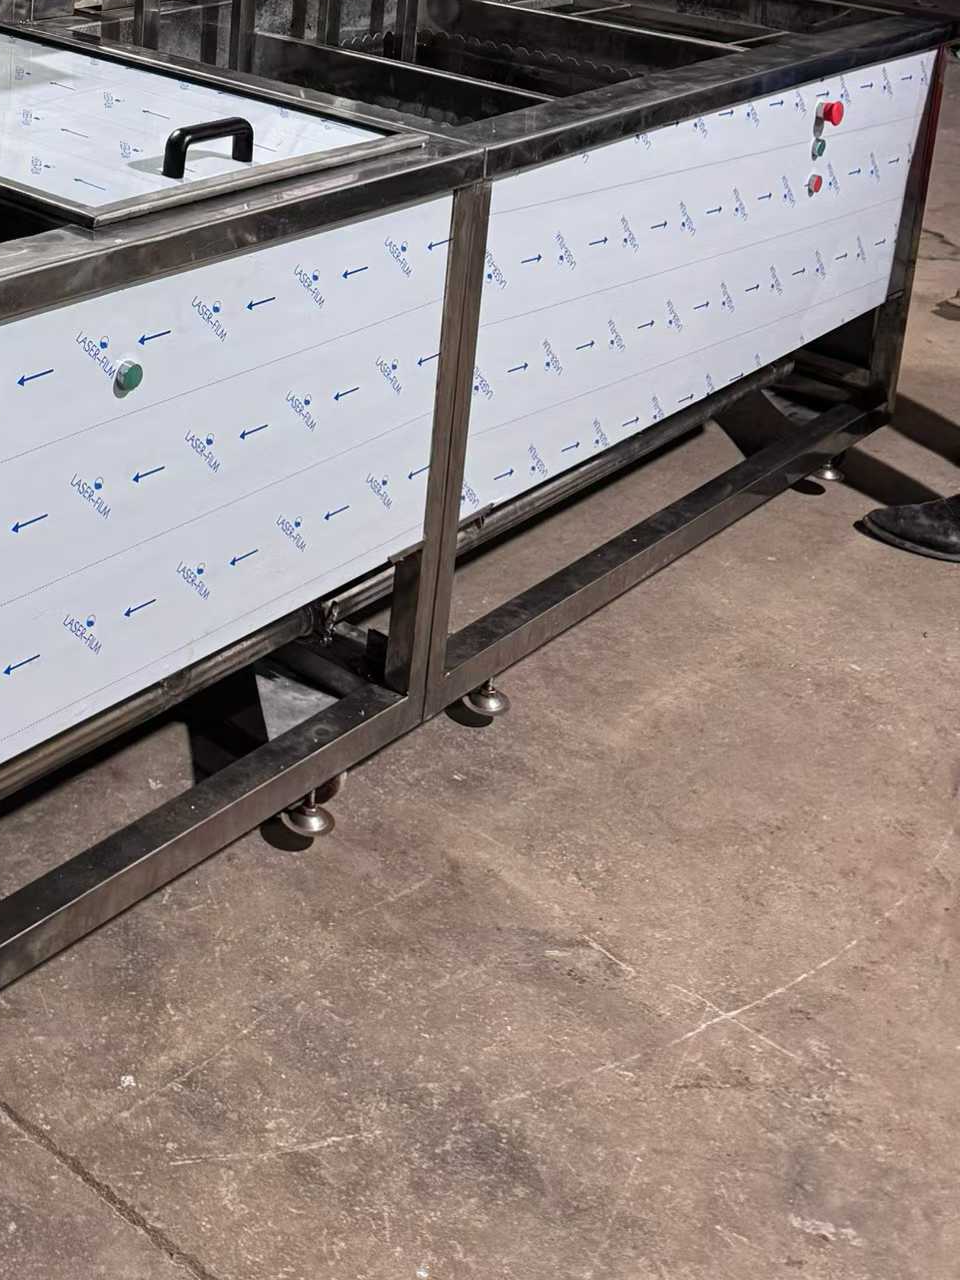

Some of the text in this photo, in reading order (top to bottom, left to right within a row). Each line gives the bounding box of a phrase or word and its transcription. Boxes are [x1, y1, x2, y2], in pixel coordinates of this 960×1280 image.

[384, 236, 412, 278] LASER-FILM
[294, 264, 325, 308] LASER-FILM
[192, 301, 227, 342] LASER-FILM
[76, 332, 117, 379] LASER-FILM
[376, 359, 401, 394] LASER-FILM
[286, 392, 316, 432] LASER-FILM
[185, 431, 220, 472] LASER-FILM
[71, 473, 111, 520] LASER-FILM
[366, 478, 392, 509] LASER-FILM
[277, 520, 306, 552] LASER-FILM
[176, 564, 210, 600] LASER-FILM
[63, 616, 102, 654] LASER-FILM
